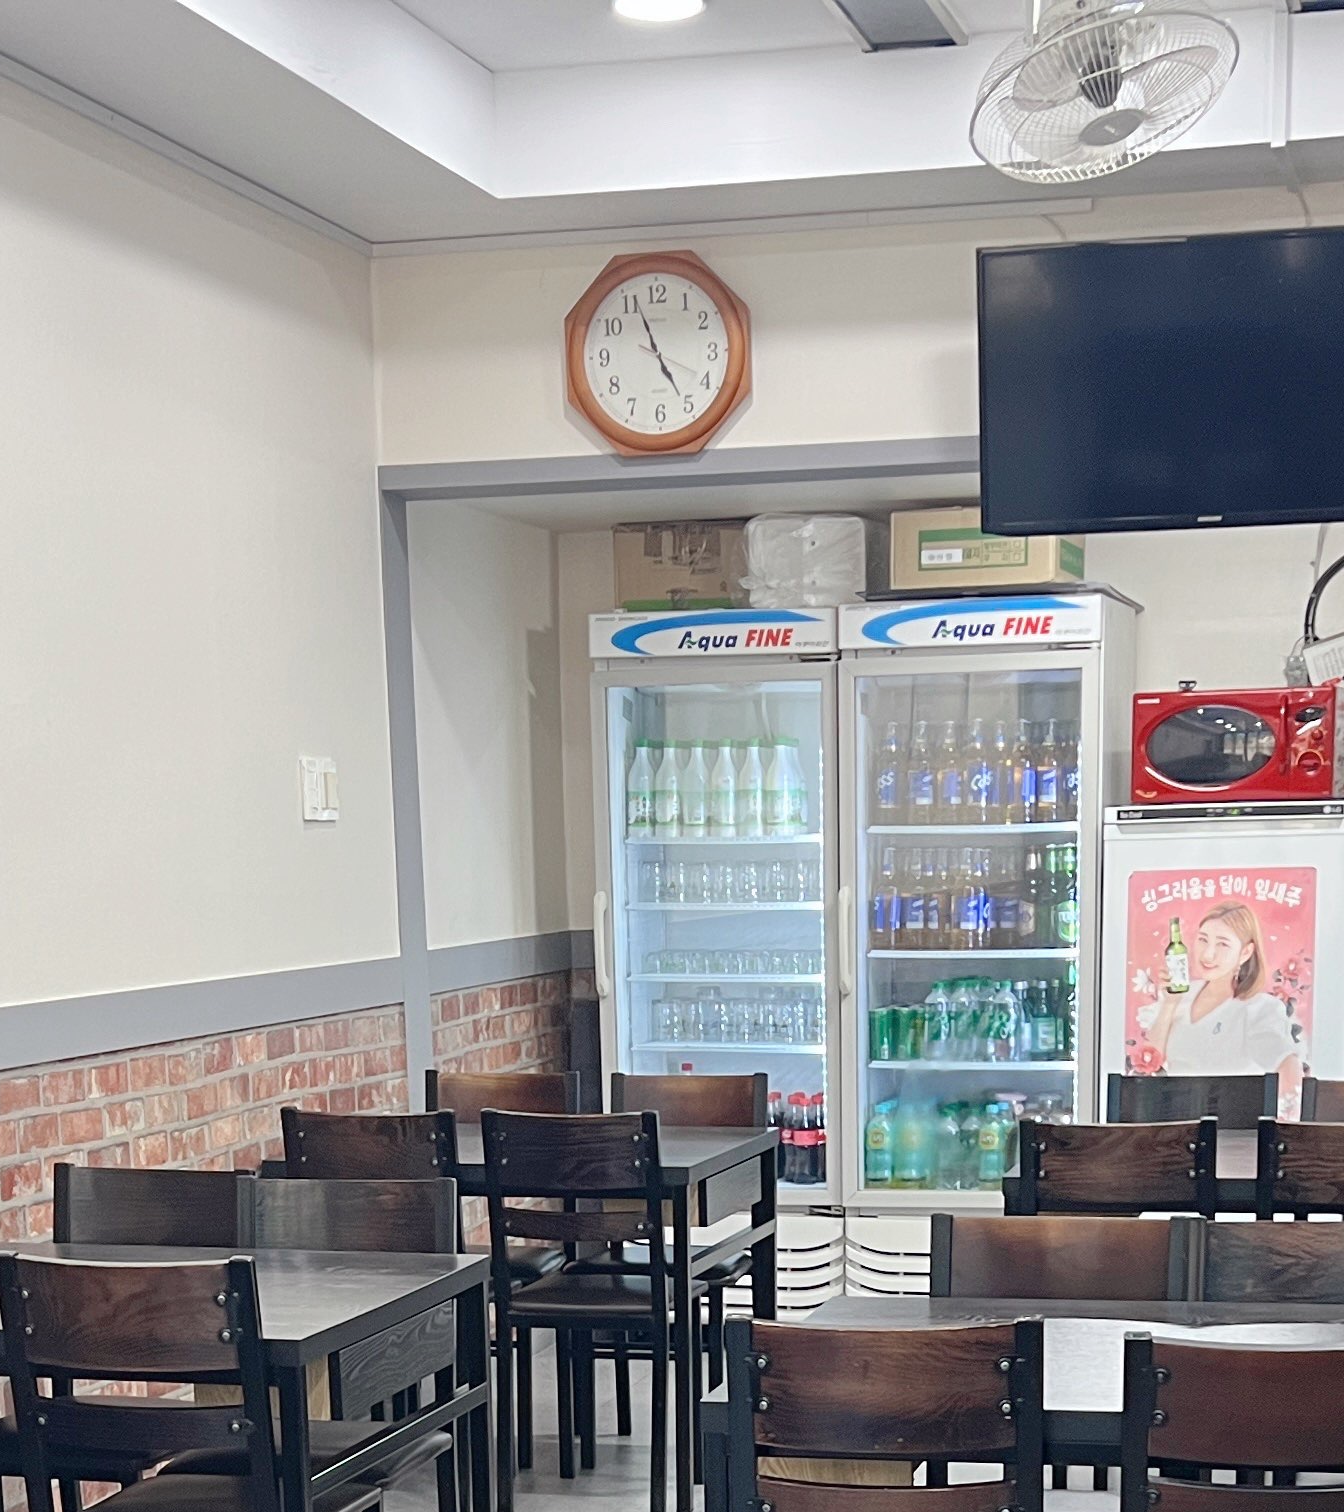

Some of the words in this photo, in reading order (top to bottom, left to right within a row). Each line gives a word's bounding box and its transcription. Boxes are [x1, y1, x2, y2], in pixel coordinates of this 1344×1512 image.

[648, 284, 667, 304] 12
[682, 292, 689, 311] 1
[623, 294, 639, 314] 11
[604, 317, 622, 337] 10
[698, 311, 708, 330] 2
[599, 348, 610, 367] 9
[707, 342, 718, 361] 3
[609, 376, 620, 395] 8
[700, 370, 710, 389] 4
[626, 398, 636, 416] 7
[656, 403, 666, 423] 6
[683, 395, 694, 413] 5
[932, 620, 995, 641] Aqua
[1002, 615, 1053, 636] FINE
[678, 631, 738, 651] Aqua
[745, 628, 794, 648] FINE
[1141, 877, 1216, 912] 싱그러움을
[1255, 878, 1303, 908] 잎새주
